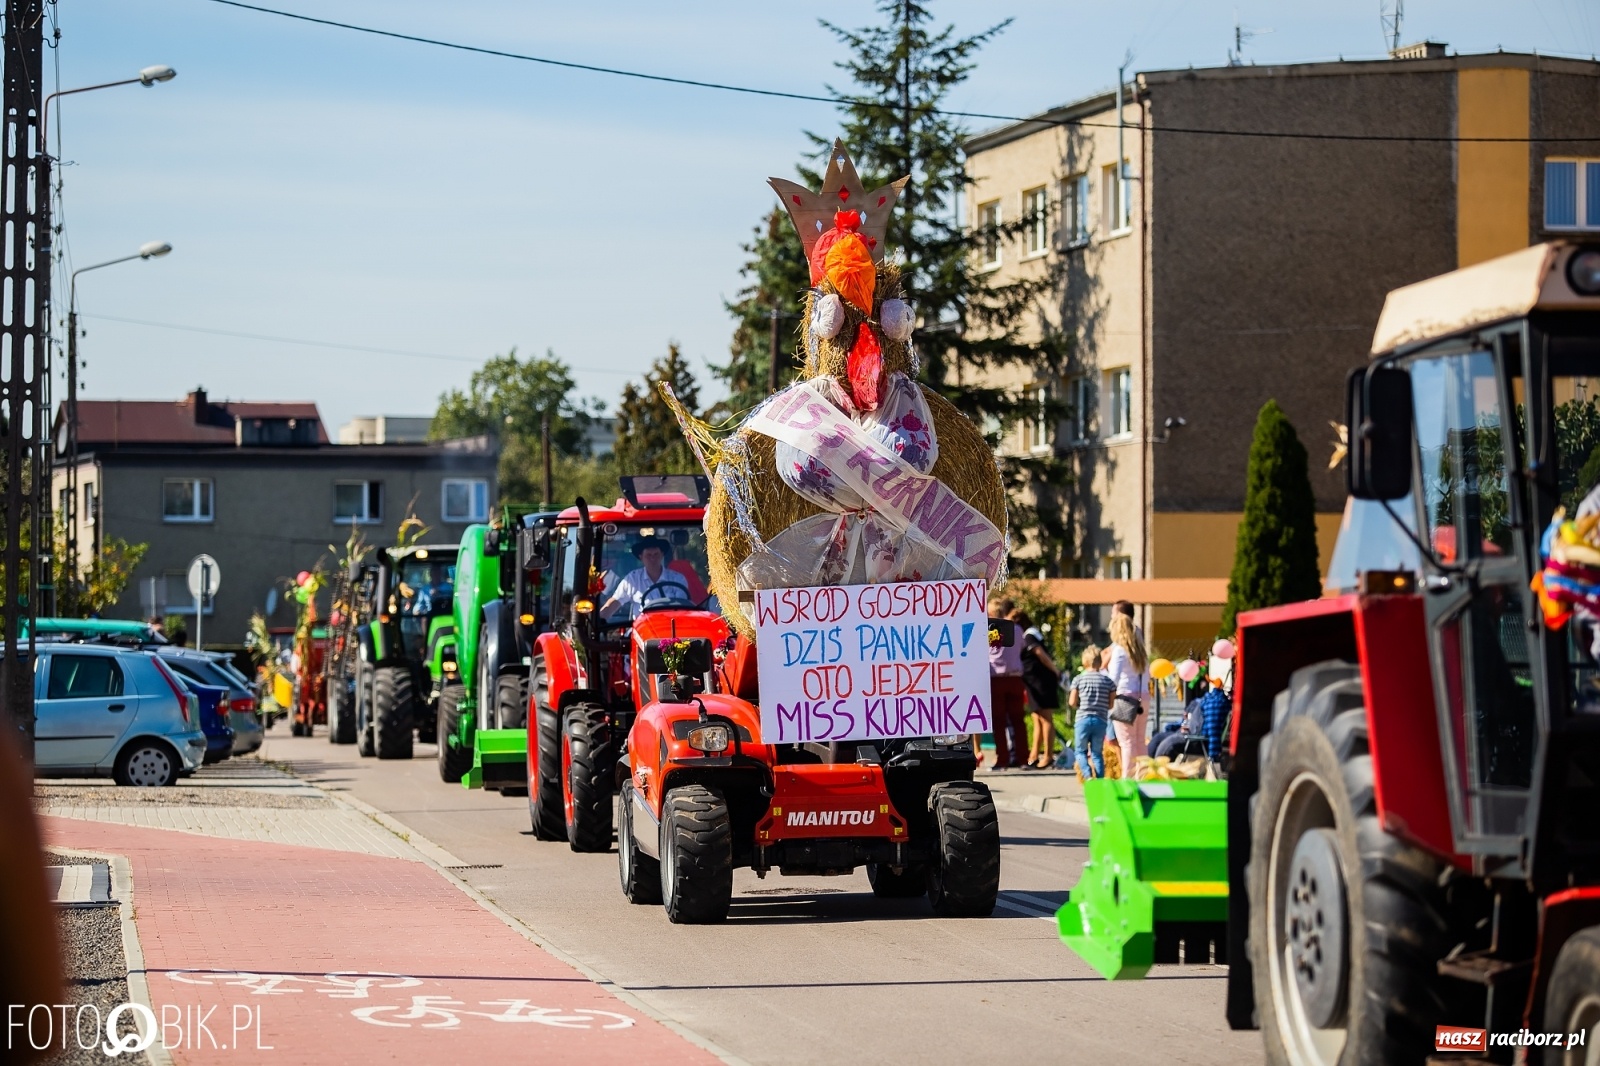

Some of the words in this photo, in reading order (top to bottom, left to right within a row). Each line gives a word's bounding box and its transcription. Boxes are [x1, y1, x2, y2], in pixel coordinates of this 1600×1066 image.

[846, 445, 1004, 584] KURNIKA
[757, 586, 849, 627] WŚRÓD
[858, 579, 986, 619] GOSPODYŃ
[781, 625, 844, 667] DZIŚ
[802, 664, 852, 700] OTO
[862, 661, 954, 696] JEDZIE
[776, 699, 855, 741] MISS
[865, 694, 988, 738] KURNIKA
[787, 810, 875, 826] MANITOU
